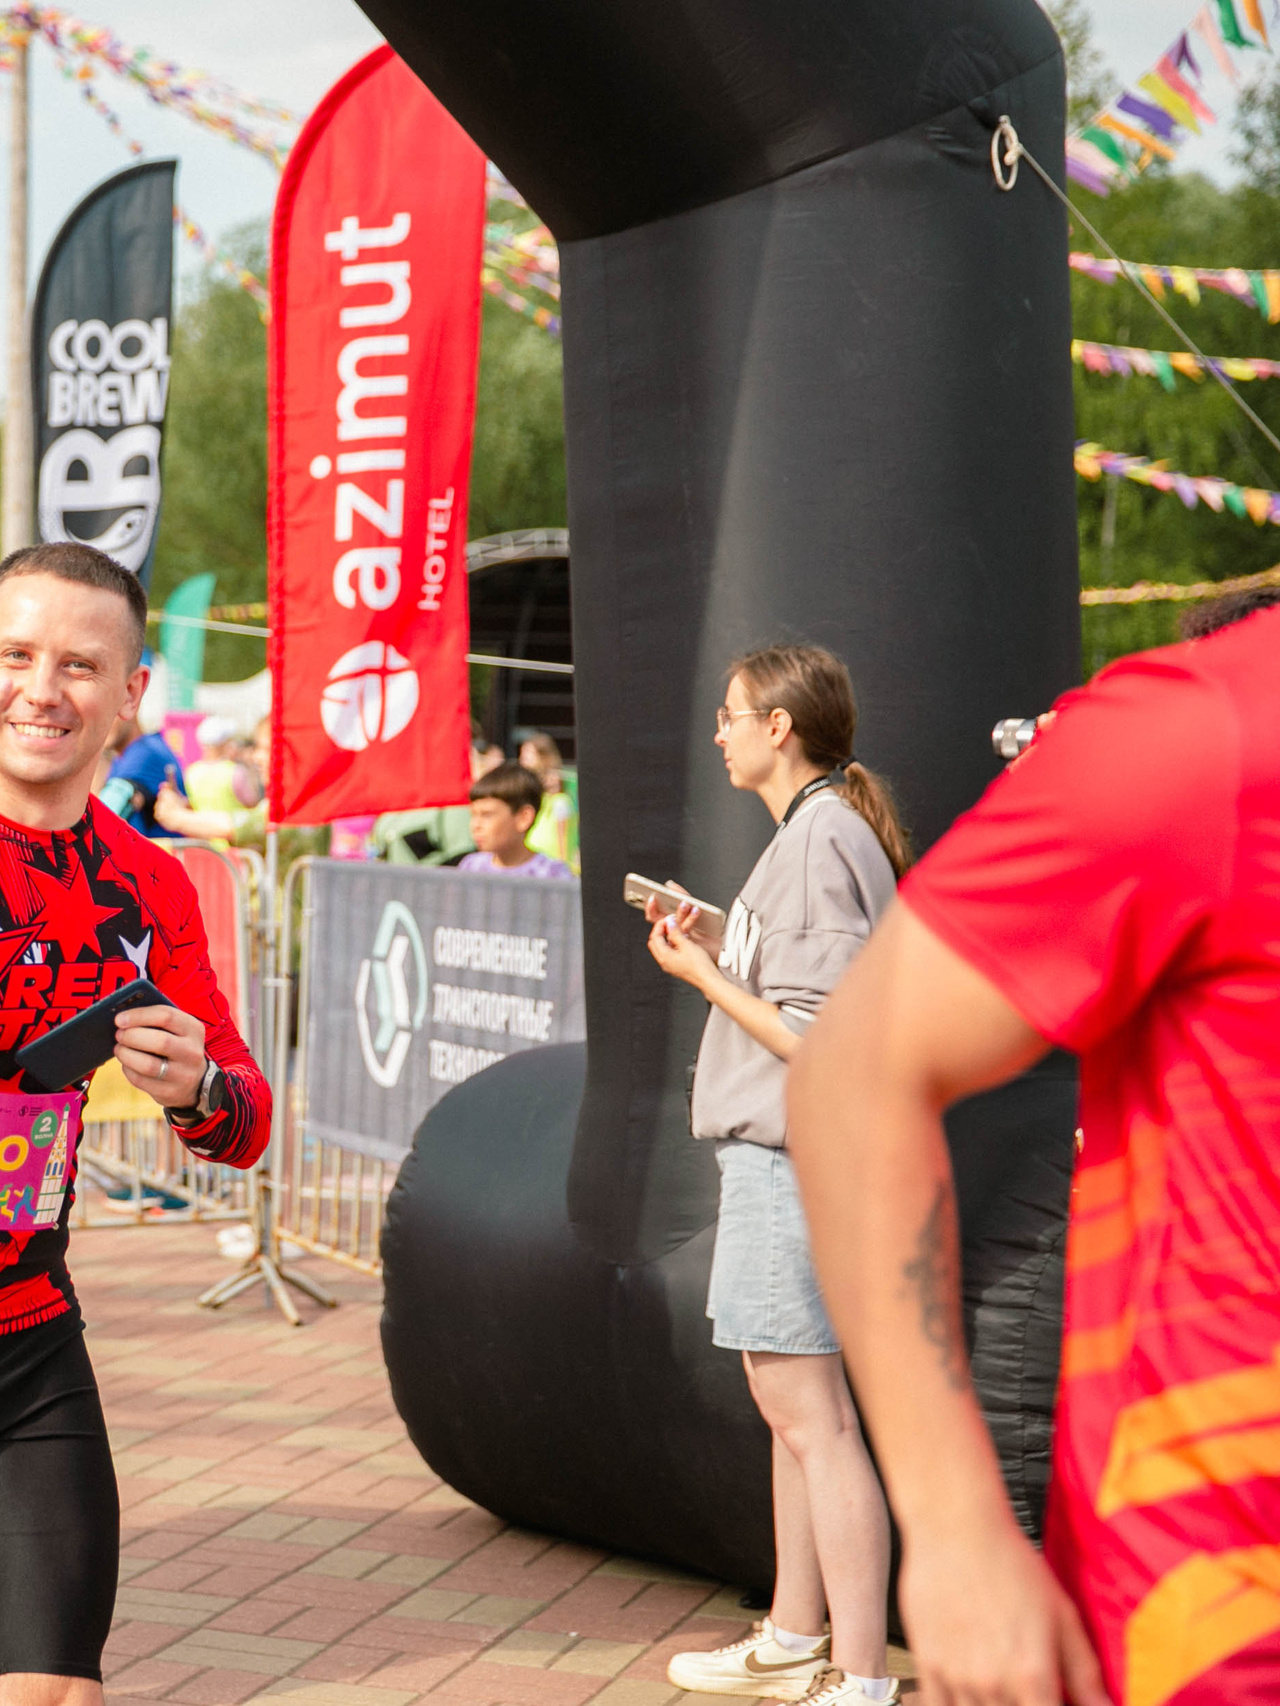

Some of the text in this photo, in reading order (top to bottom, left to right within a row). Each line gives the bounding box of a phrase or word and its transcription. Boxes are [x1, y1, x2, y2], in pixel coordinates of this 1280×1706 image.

[48, 317, 172, 375] COOL
[47, 369, 170, 428] BREW
[310, 211, 413, 612] azimut
[418, 486, 456, 612] HOTEL
[1, 961, 139, 1010] RED
[39, 1116, 52, 1133] 2
